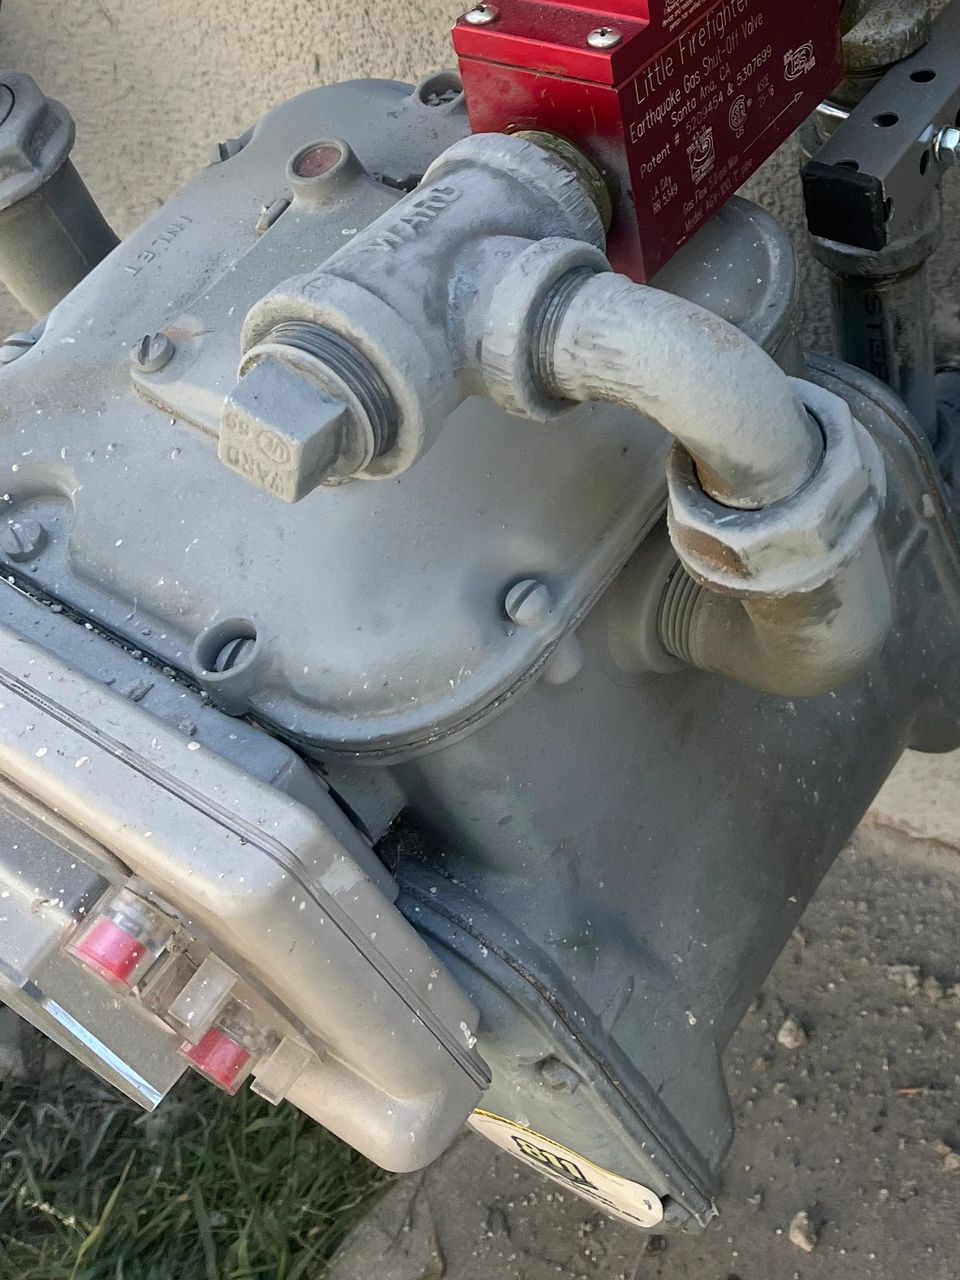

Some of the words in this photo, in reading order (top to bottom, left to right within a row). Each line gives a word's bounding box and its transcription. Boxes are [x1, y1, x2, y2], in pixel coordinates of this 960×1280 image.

[629, 87, 681, 144] Earthquake
[683, 70, 701, 94] Gas
[702, 28, 740, 76] Shut-Off
[741, 12, 763, 38] Valve
[633, 55, 674, 105] Little
[671, 96, 697, 127] Santa
[719, 62, 731, 81] CA
[640, 142, 671, 179] Patent
[685, 90, 724, 135] 5209454
[726, 81, 735, 96] &
[736, 44, 772, 87] 5307699
[683, 200, 695, 215] Gas
[124, 215, 193, 278] INLET
